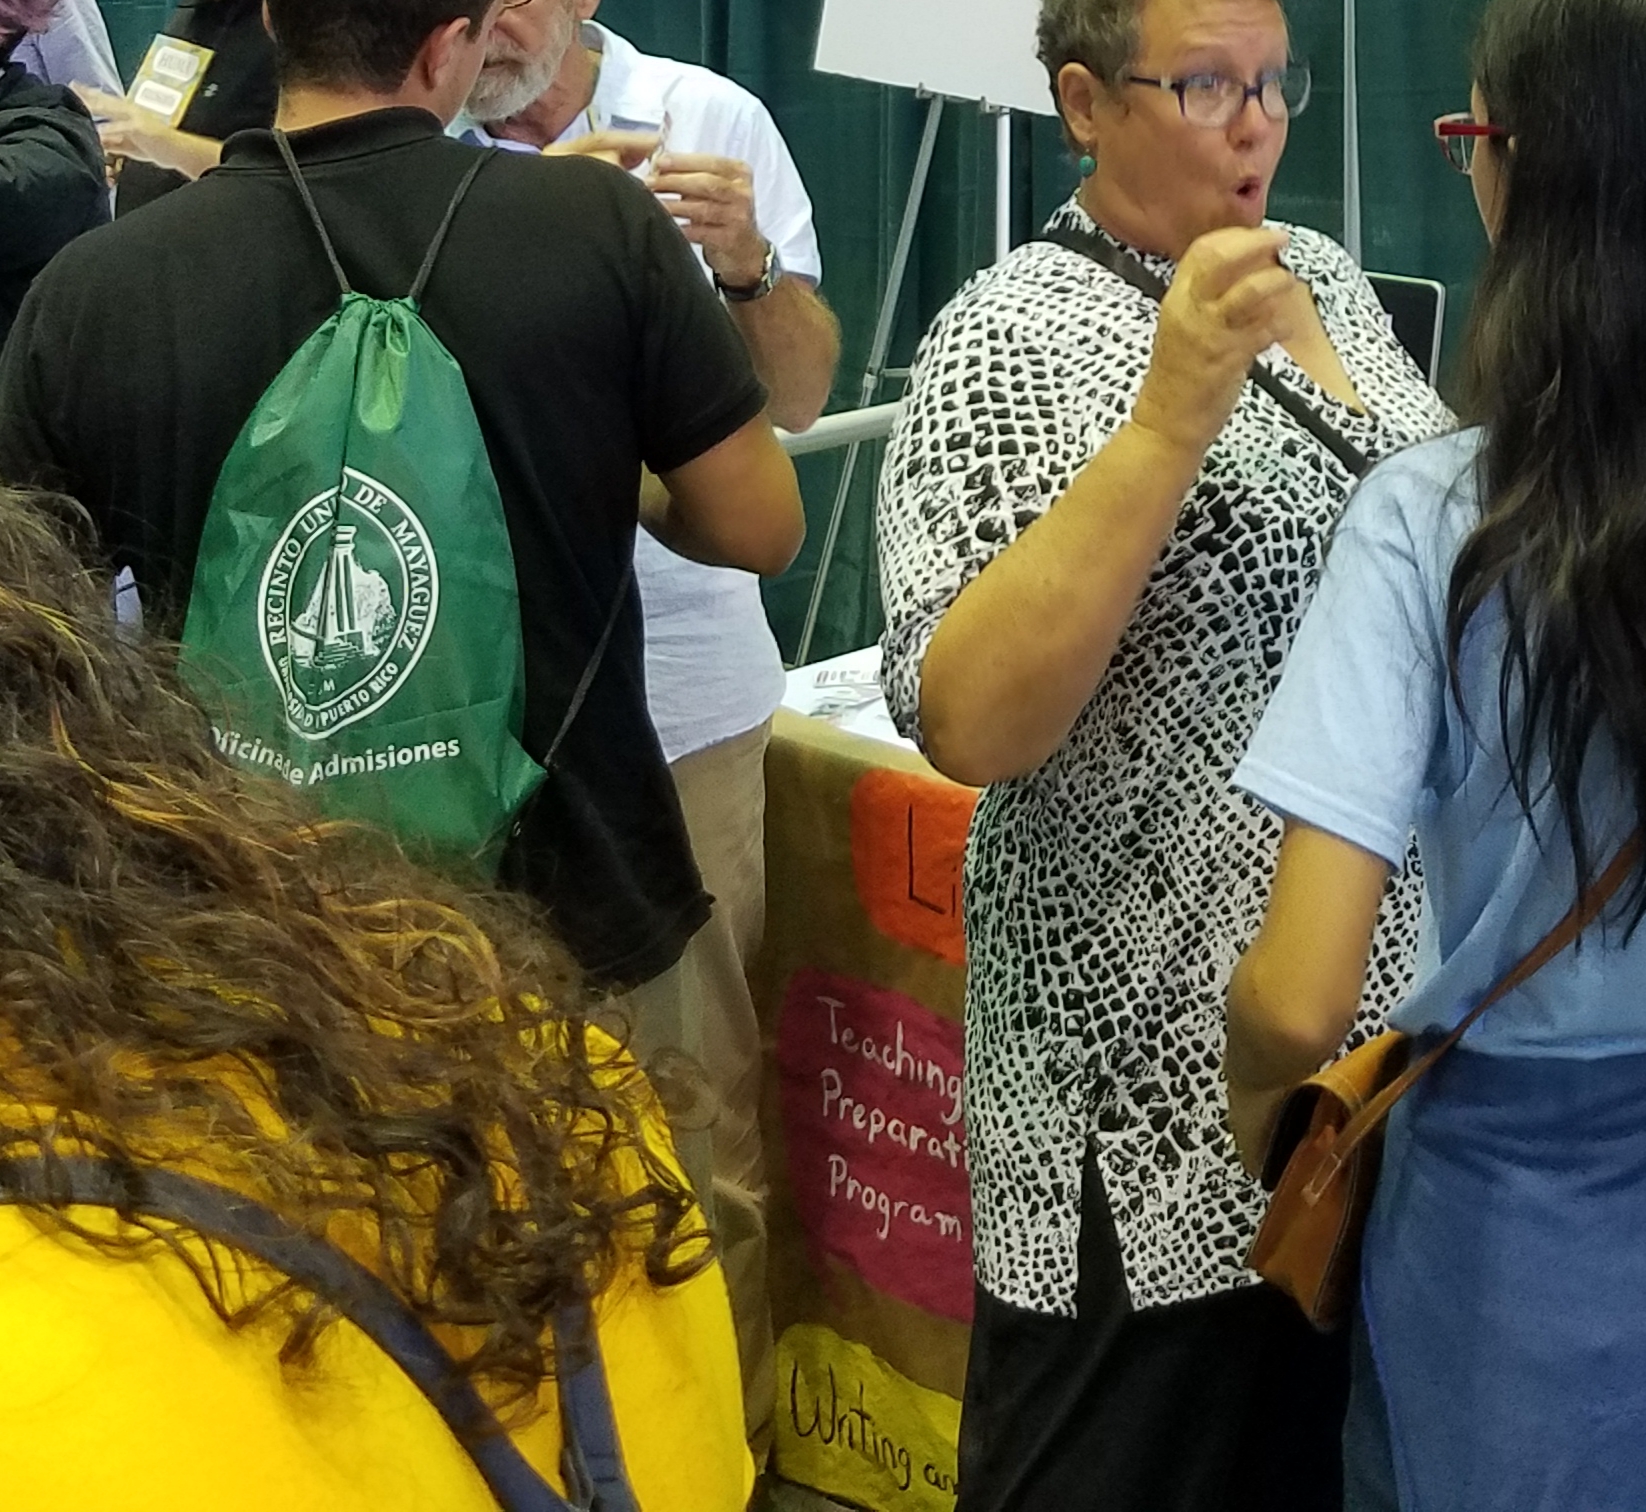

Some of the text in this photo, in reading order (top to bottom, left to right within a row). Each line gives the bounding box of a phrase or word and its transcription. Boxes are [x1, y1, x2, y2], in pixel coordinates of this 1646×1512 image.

[266, 537, 302, 647] RECINTO
[353, 484, 388, 514] DE
[391, 518, 432, 651] MAYAGUEZ
[320, 689, 370, 727] PUERTO
[368, 661, 400, 694] RICO
[308, 738, 461, 785] Admisiones
[816, 995, 962, 1126] Teaching
[828, 1153, 963, 1243] Program
[790, 1359, 911, 1491] Writing
